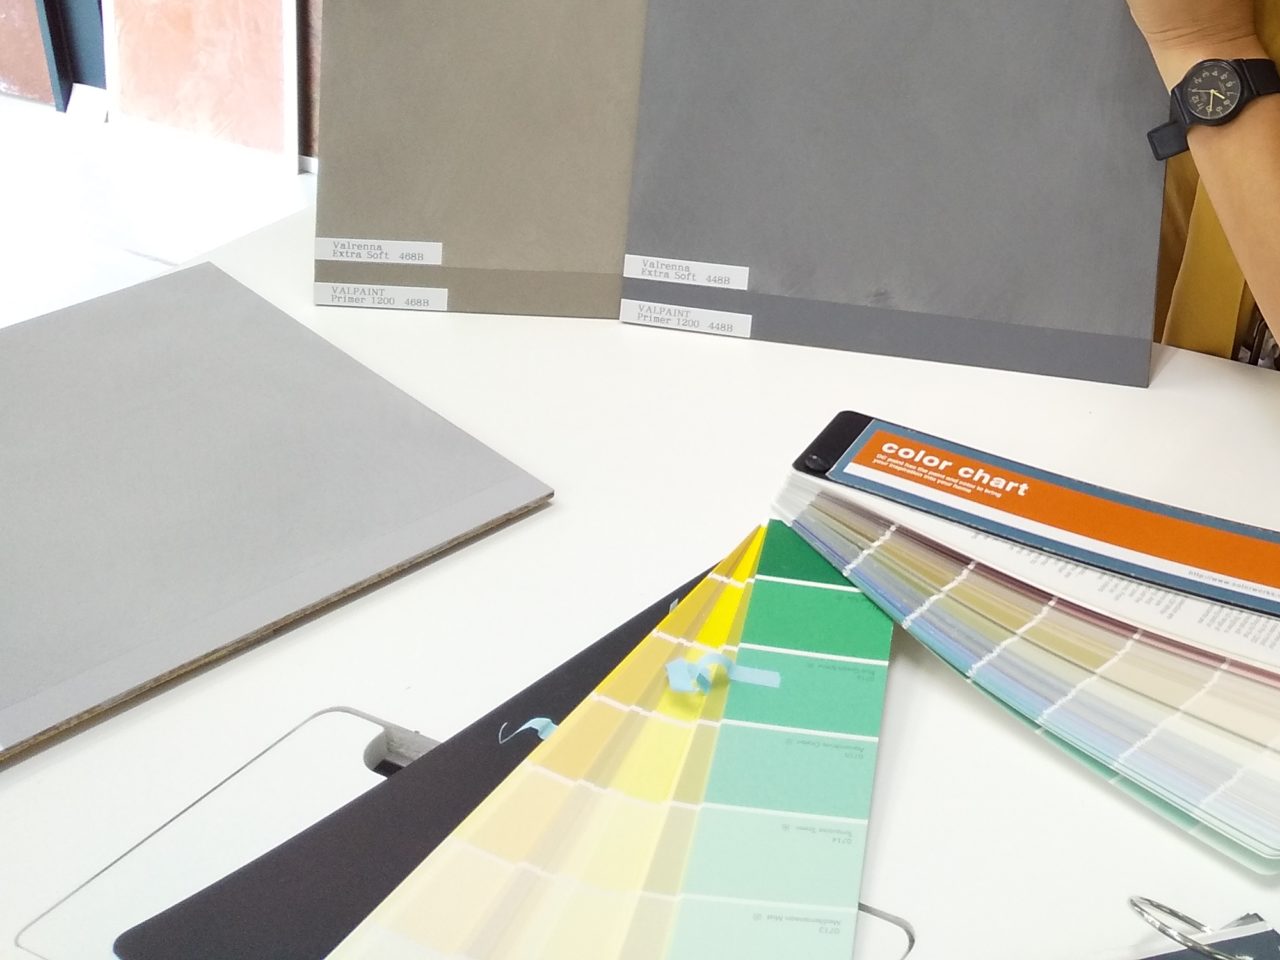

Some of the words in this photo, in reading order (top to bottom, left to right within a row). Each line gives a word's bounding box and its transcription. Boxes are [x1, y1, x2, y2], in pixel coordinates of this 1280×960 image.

[333, 241, 383, 251] Valrenna
[332, 249, 363, 258] Extra
[366, 251, 390, 260] Soft
[399, 252, 424, 261] 468B
[641, 259, 691, 272] Valrenna
[640, 267, 670, 279] Extra
[674, 271, 697, 281] Soft
[705, 275, 731, 285] 448B
[331, 286, 386, 297] VALPAINT
[330, 294, 367, 304] Primer
[371, 296, 396, 306] 1200
[404, 298, 430, 307] 468B
[638, 304, 691, 318] VALPAINT
[637, 312, 672, 325] Primer
[676, 318, 700, 329] 1200
[708, 321, 734, 333] 448B
[881, 442, 953, 471] color
[957, 466, 1030, 496] chart
